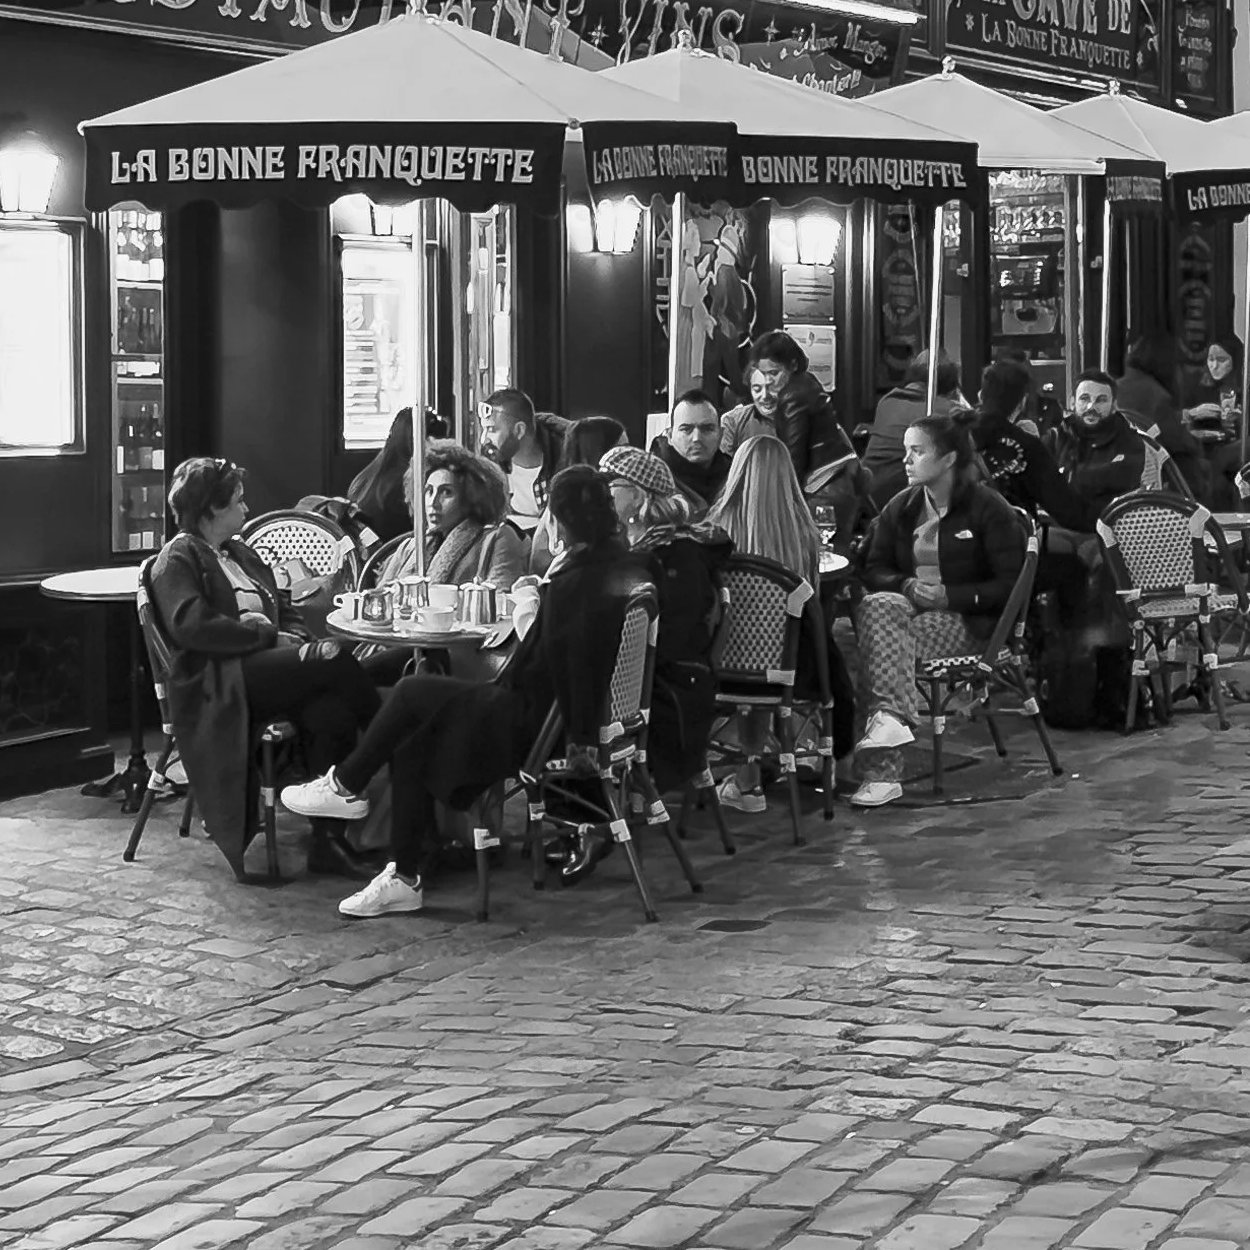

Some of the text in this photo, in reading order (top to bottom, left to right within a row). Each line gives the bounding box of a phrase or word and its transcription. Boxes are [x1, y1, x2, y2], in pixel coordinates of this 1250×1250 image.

[982, 13, 1130, 69] LA BONNE FRANQUETTE
[110, 144, 535, 187] LA BONNE FRANQUETTE
[593, 144, 728, 184] LA BONNE FRANQUETTE
[741, 156, 968, 190] BONNE FRANQUETTE
[1188, 187, 1208, 210] LA
